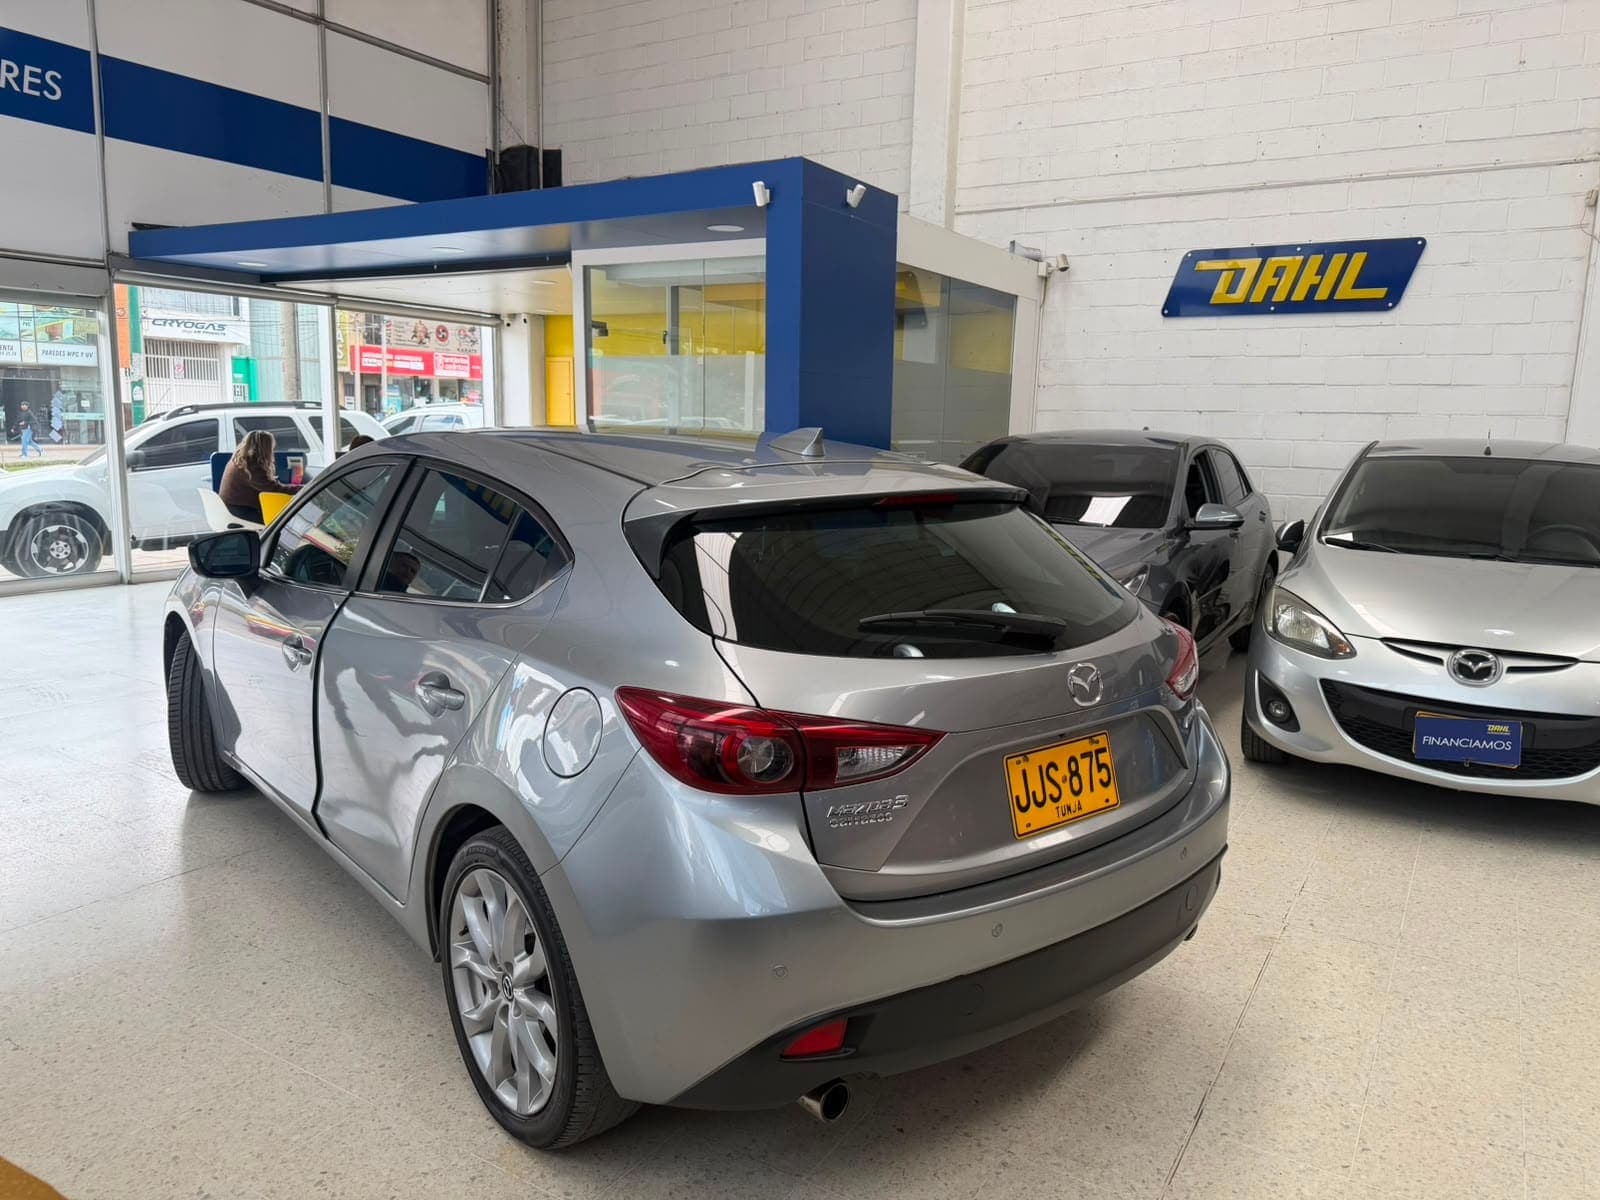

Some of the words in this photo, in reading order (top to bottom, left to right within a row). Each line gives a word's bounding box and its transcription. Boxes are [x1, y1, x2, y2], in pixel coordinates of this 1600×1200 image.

[0, 58, 63, 101] RES
[1194, 252, 1388, 304] DAHL
[152, 318, 226, 331] CRYOGAS
[41, 349, 66, 357] PAREDES
[1422, 735, 1513, 751] FINANCIAMOS
[1056, 800, 1083, 818] TUNJA
